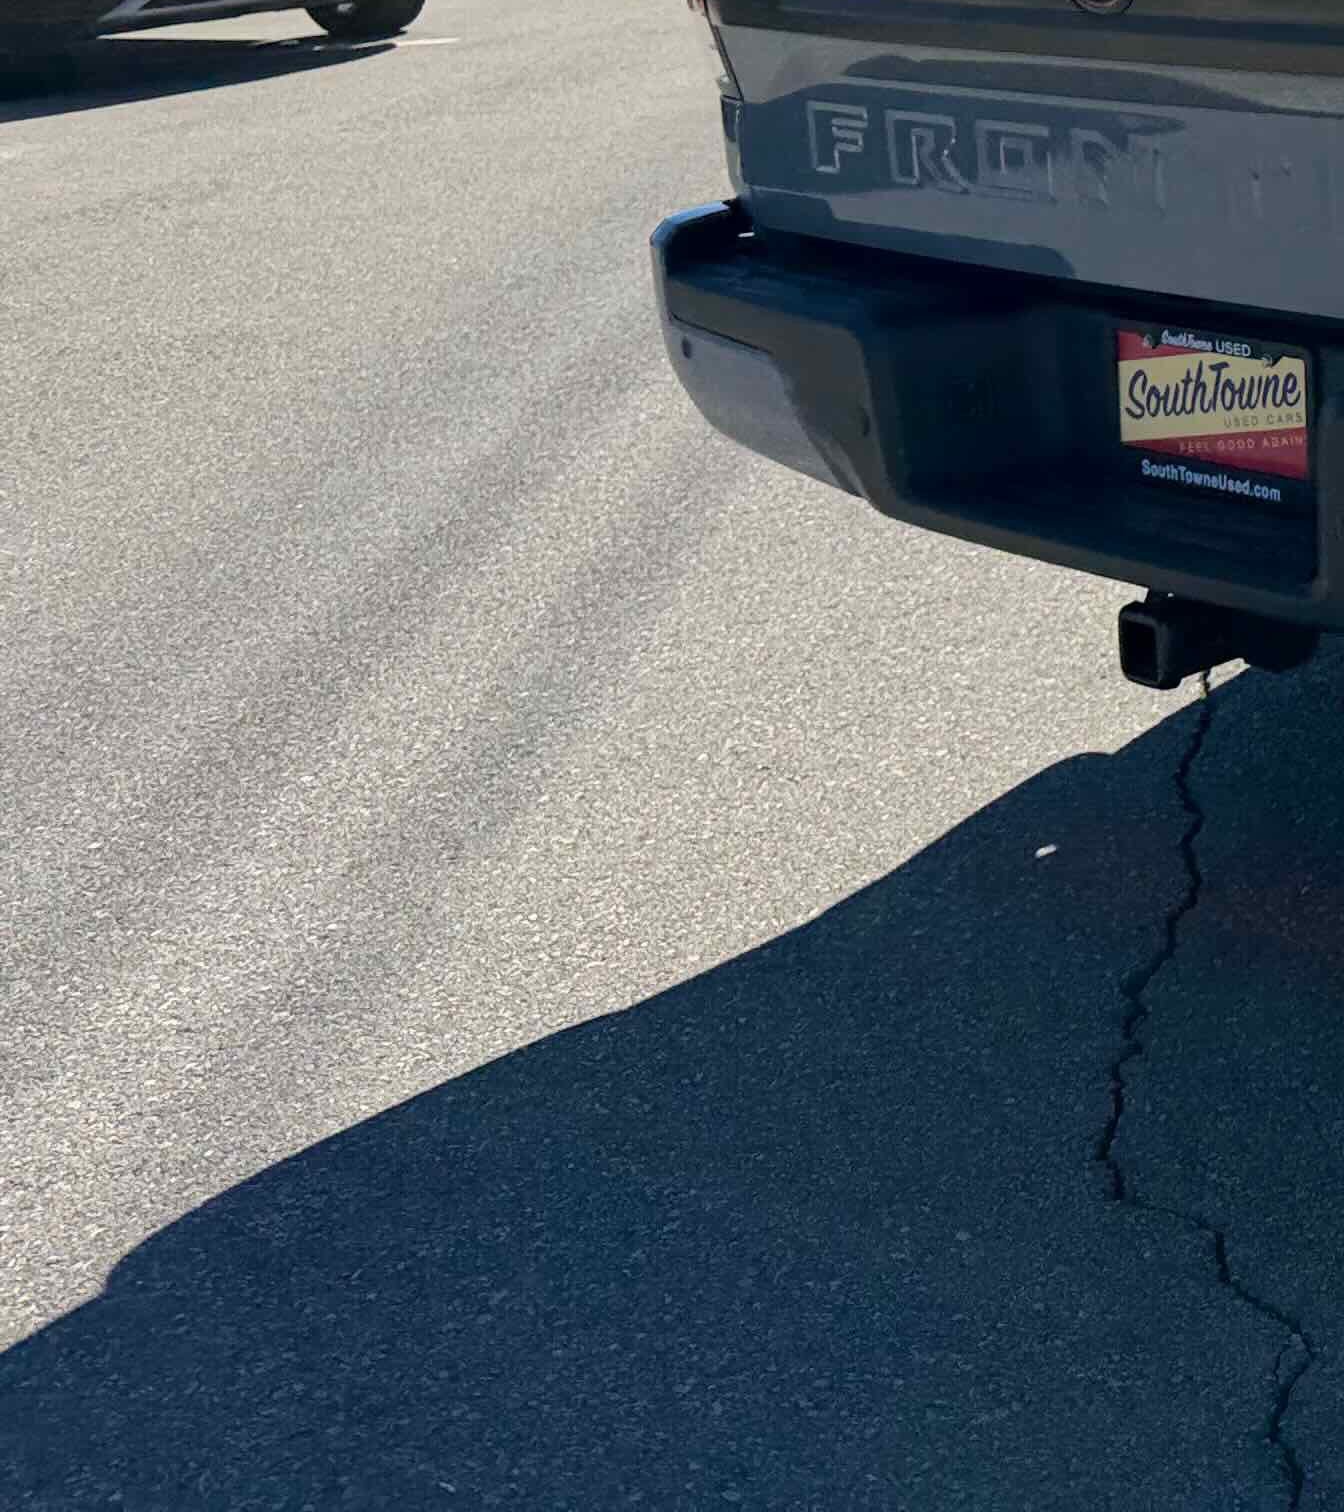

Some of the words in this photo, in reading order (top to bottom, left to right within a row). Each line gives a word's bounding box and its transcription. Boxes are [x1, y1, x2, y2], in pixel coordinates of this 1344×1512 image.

[1215, 341, 1251, 358] USED
[1125, 359, 1302, 420] SouthTowne
[1223, 416, 1260, 430] USED
[1266, 413, 1303, 427] CARS
[1216, 438, 1256, 452] GOOD
[1141, 458, 1282, 502] SouthTowneUsed.com
